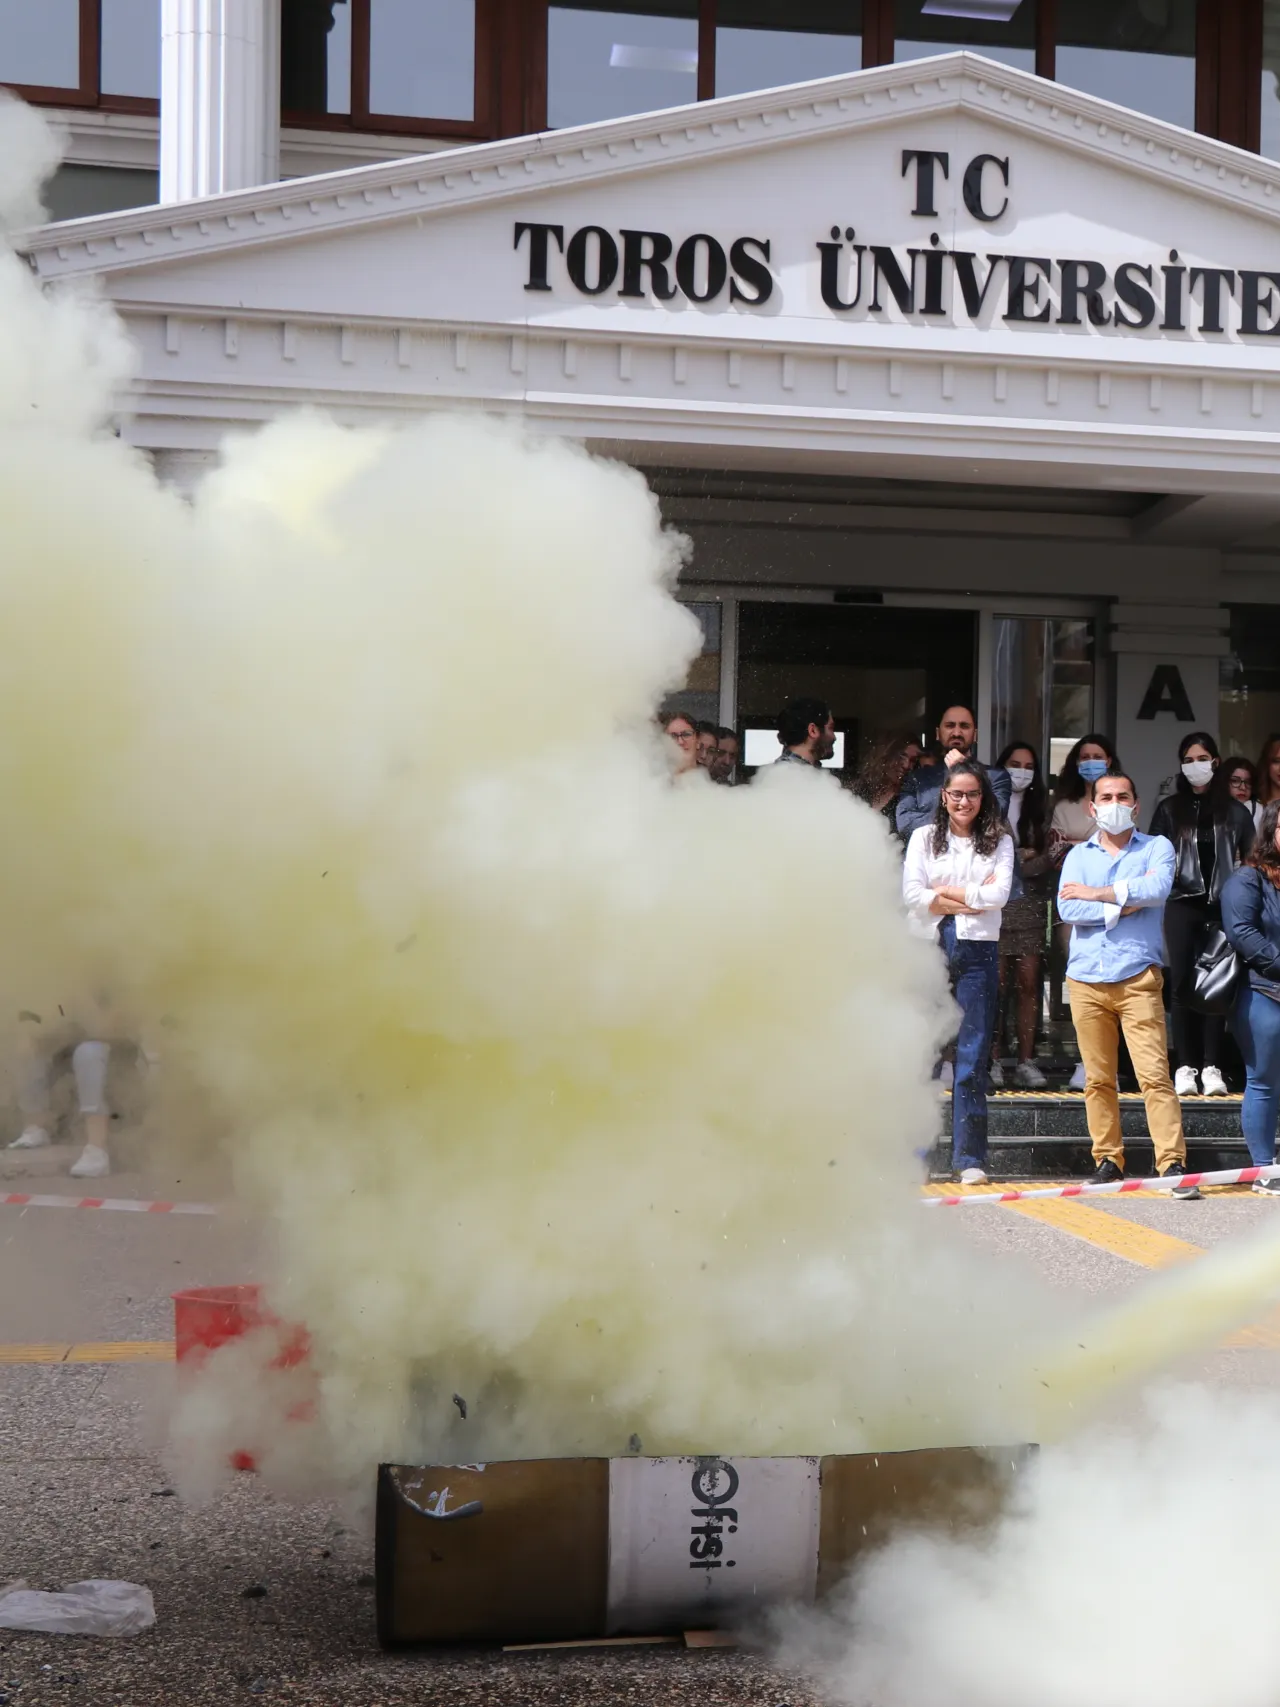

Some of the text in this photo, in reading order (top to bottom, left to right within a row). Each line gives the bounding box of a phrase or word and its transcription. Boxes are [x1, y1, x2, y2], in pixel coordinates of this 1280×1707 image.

[514, 222, 773, 306] TOROS
[1136, 664, 1196, 722] A
[689, 1459, 739, 1569] Ofisi
